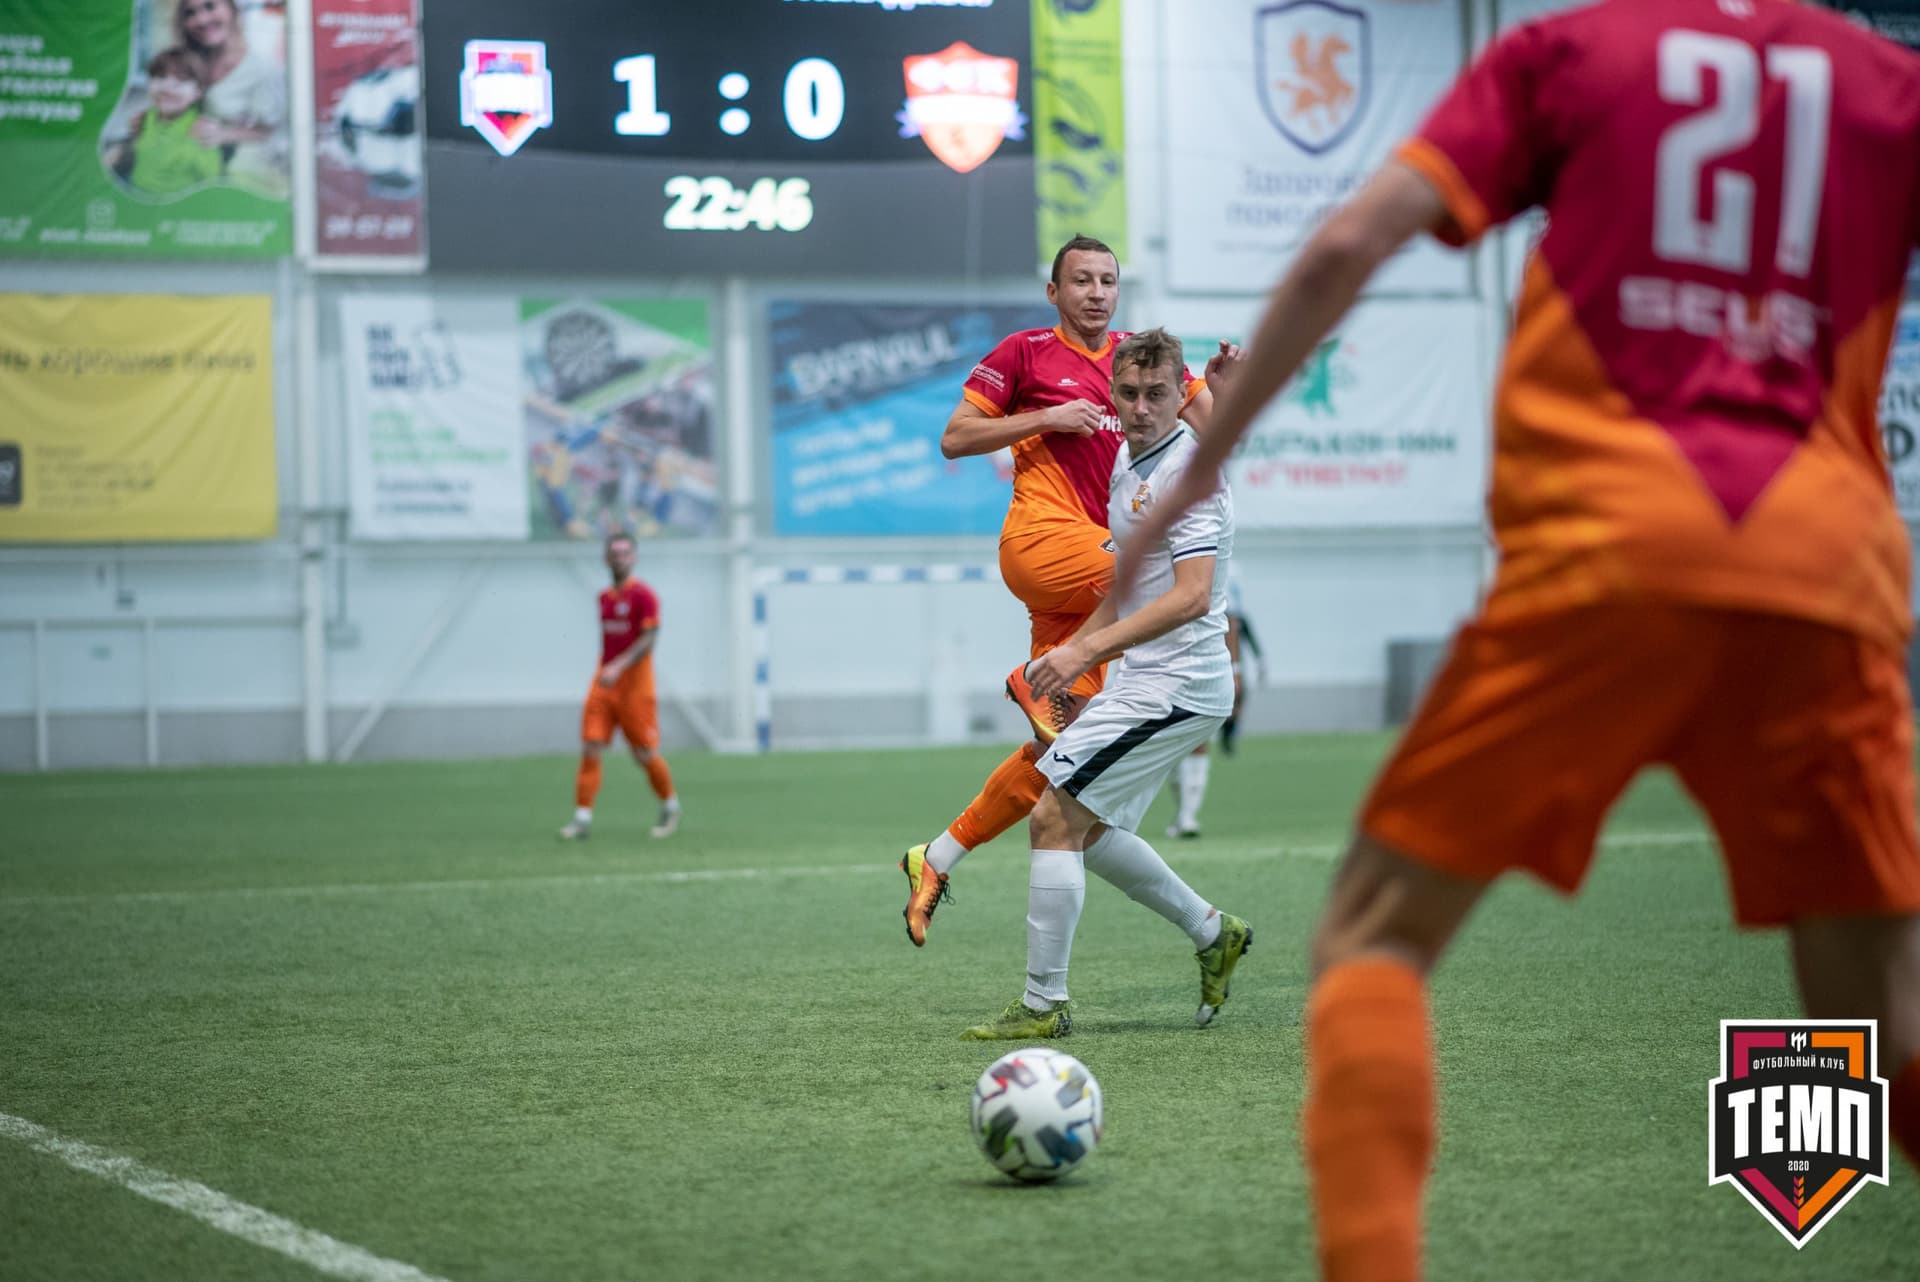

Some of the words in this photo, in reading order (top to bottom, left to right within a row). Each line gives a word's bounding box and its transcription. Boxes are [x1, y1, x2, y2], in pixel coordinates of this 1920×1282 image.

[613, 54, 671, 136] 1
[783, 57, 846, 141] 0
[1655, 28, 1832, 277] 21
[663, 176, 813, 231] 22:46
